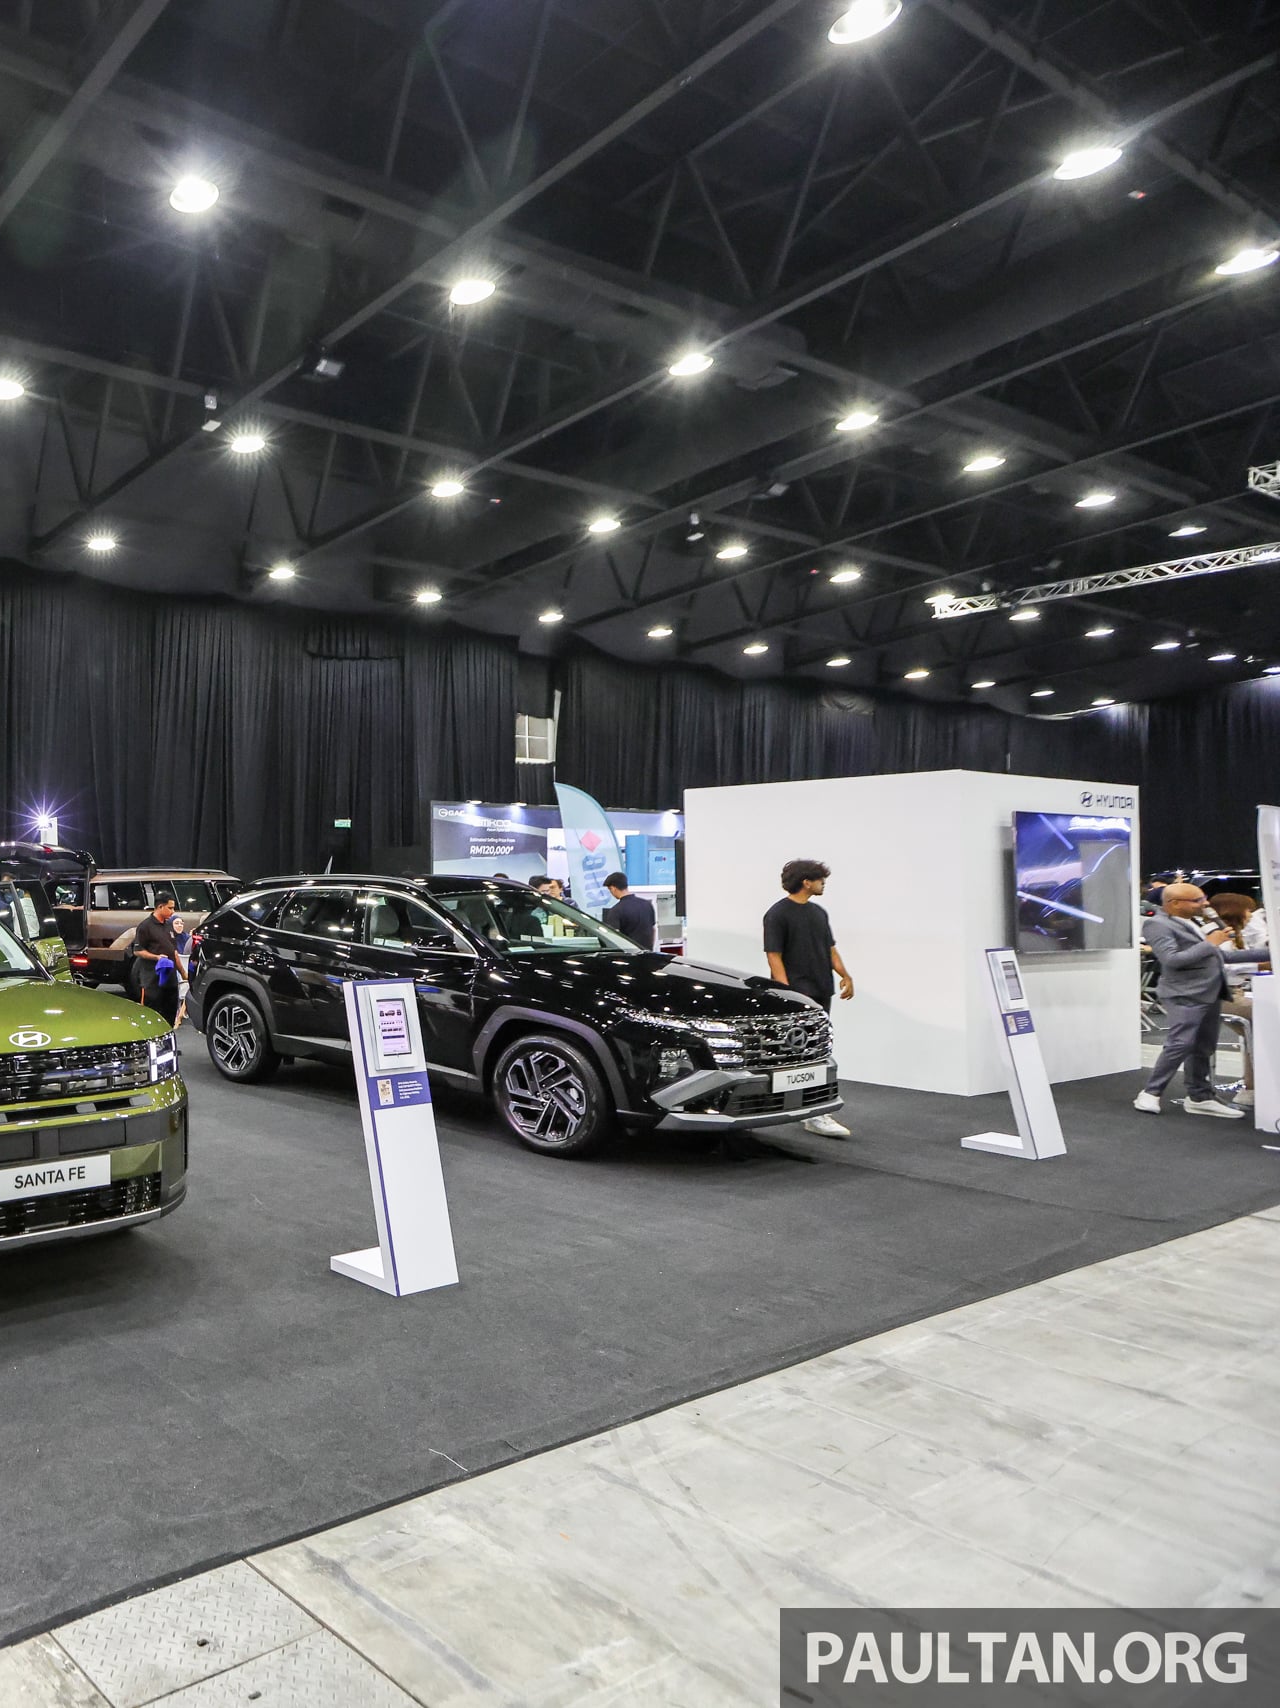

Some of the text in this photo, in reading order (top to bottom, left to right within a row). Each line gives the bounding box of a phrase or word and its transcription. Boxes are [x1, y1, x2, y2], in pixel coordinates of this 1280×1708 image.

[1096, 794, 1135, 809] HYUNDAI
[786, 1071, 816, 1085] TUCSON
[14, 1165, 86, 1189] SANTA FE
